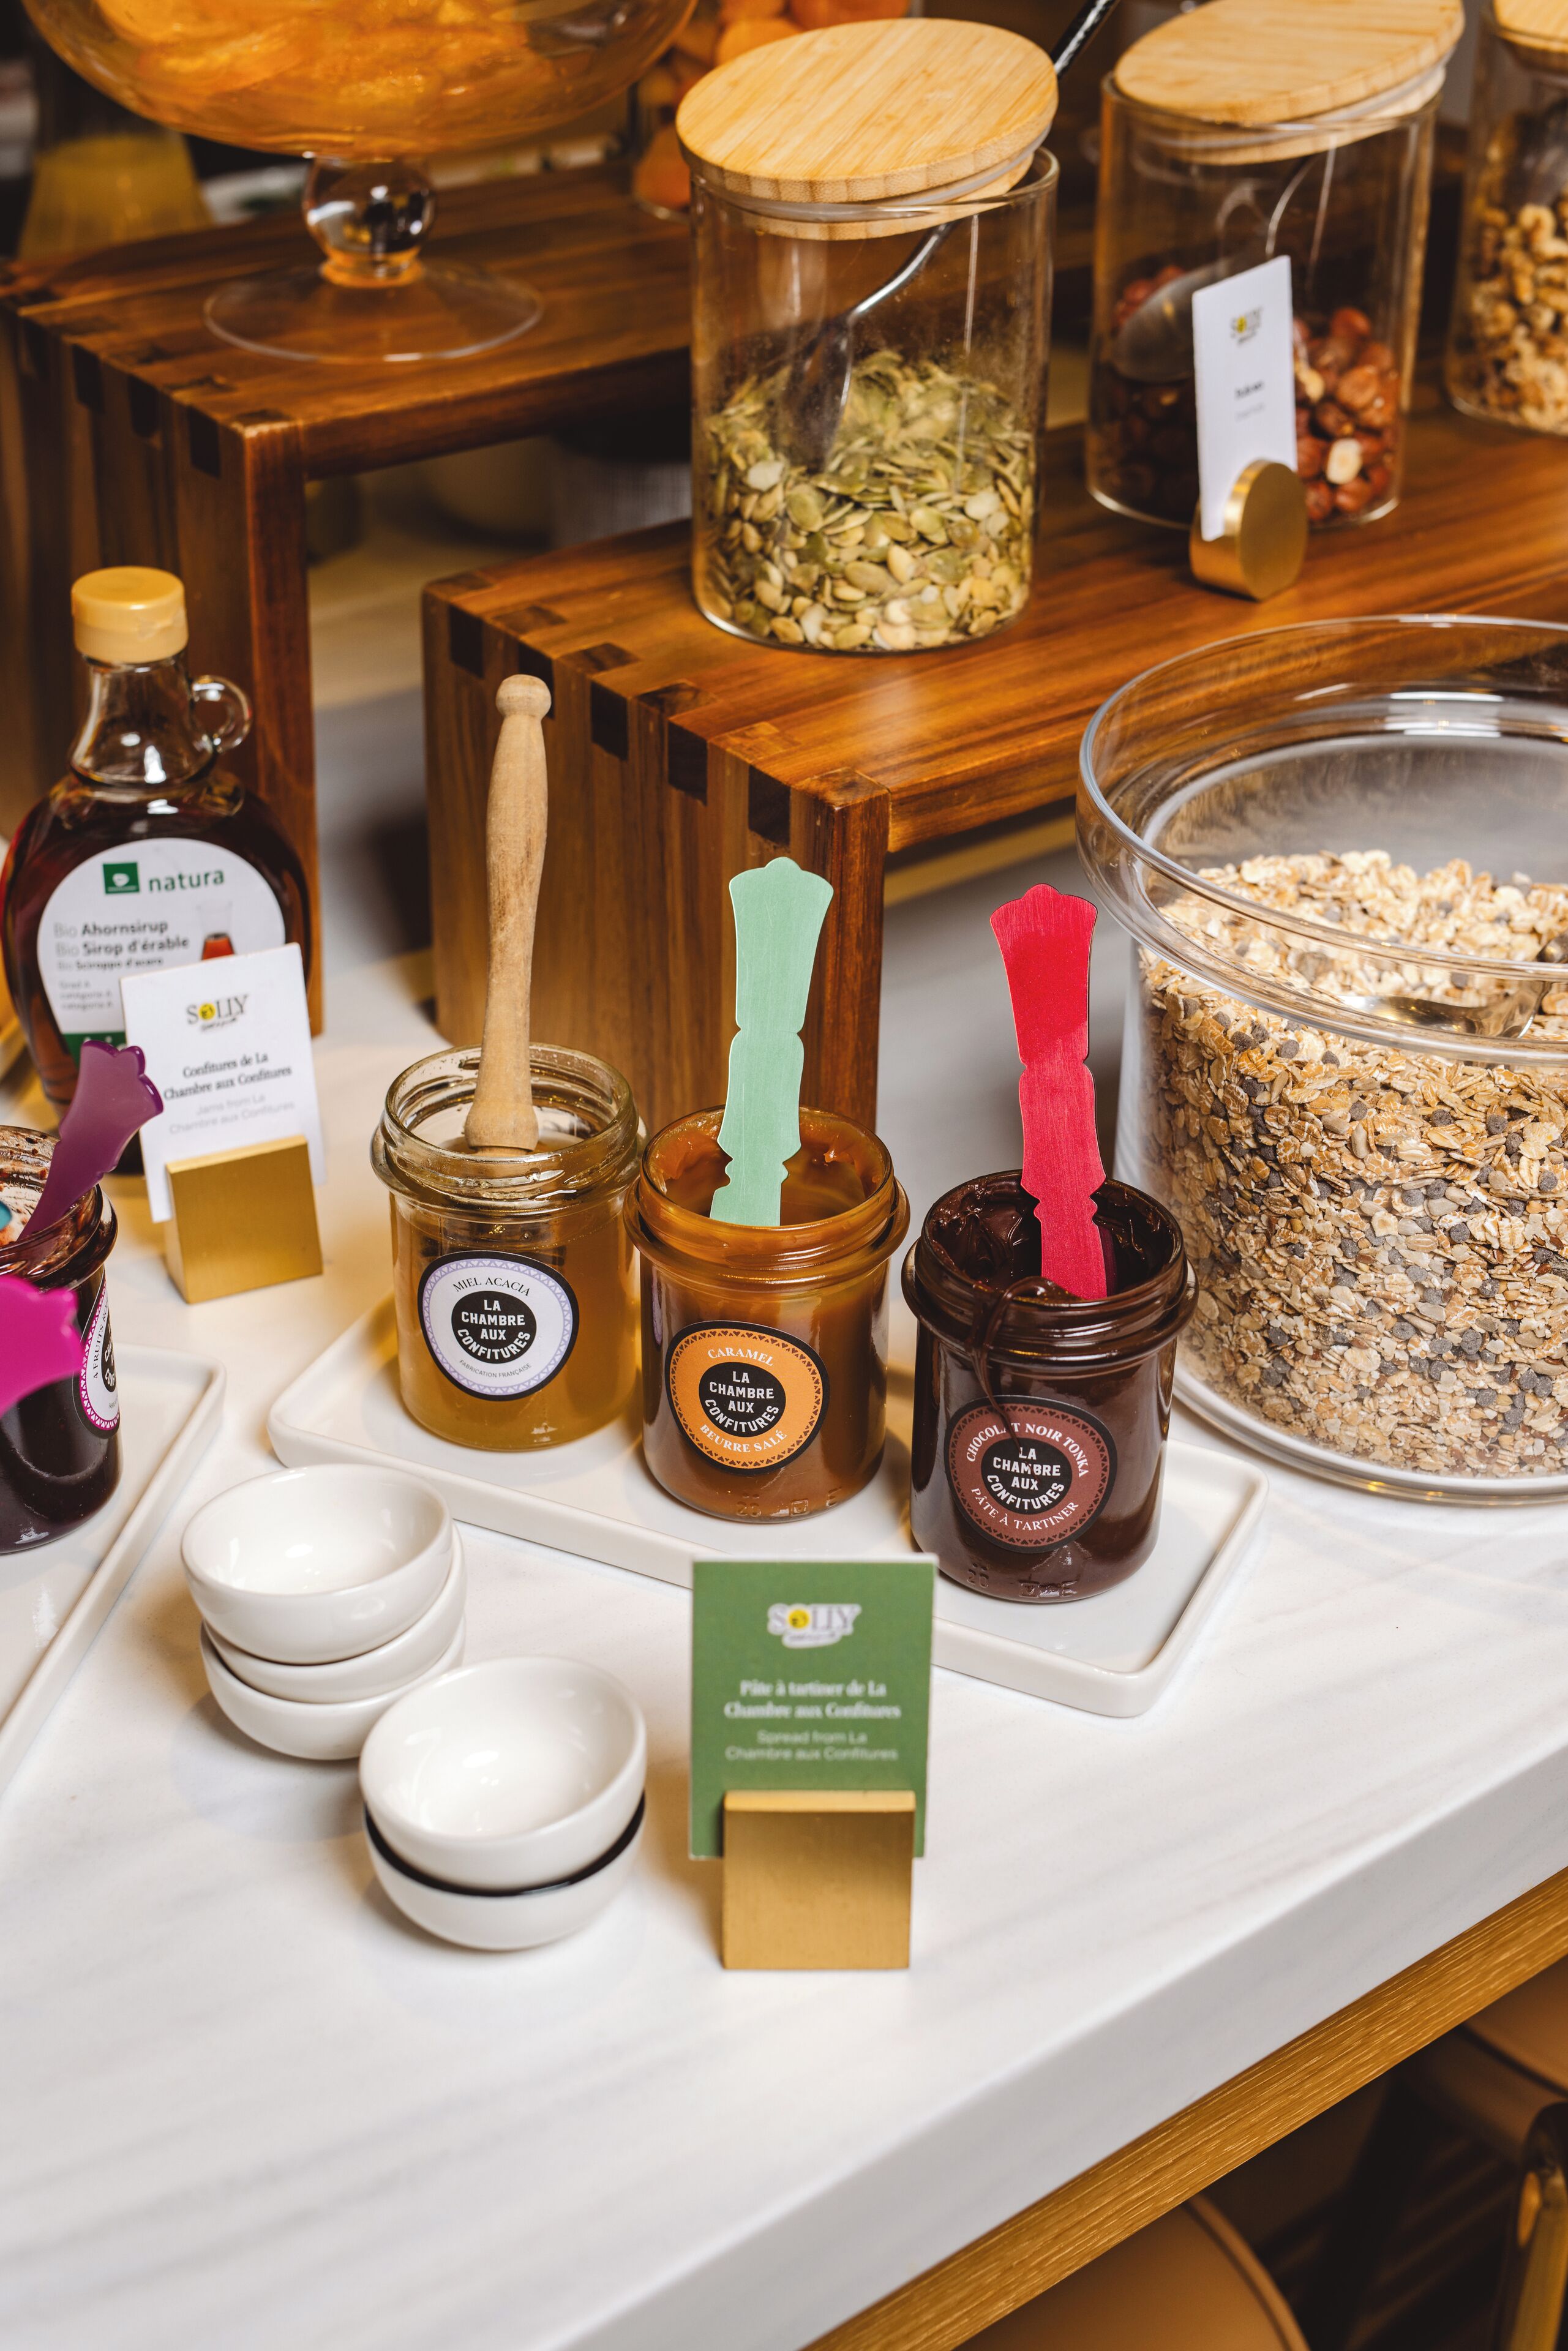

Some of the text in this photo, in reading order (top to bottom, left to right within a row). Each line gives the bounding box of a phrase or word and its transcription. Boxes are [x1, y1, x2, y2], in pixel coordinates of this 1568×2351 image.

[149, 870, 224, 891] natura
[82, 920, 168, 936] Ahornsirup
[83, 940, 122, 956] Sirop
[186, 993, 250, 1026] SOLLY
[183, 1052, 268, 1079] Confitures de La
[163, 1067, 292, 1101] Chambre aux Confitures
[169, 1117, 219, 1134] Chambre
[241, 1100, 295, 1119] Confitures
[452, 1277, 530, 1297] MIEL ACACIA
[483, 1299, 501, 1311] LA
[461, 1311, 525, 1326] CHAMBRE
[457, 1329, 531, 1360] CONFITURES
[480, 1329, 506, 1340] AUX
[92, 1324, 103, 1370] FRUITS
[707, 1347, 773, 1367] CARAMEL
[459, 1359, 532, 1378] FABRICATION FRANÇAISE
[732, 1371, 750, 1384] LA
[710, 1381, 775, 1399] CHAMBRE
[705, 1399, 779, 1433] CONFITURES
[728, 1400, 754, 1413] AUX
[700, 1424, 787, 1453] BEURRE SALÉ
[966, 1422, 1089, 1477] CHOCOLT NOIR TONKA
[1018, 1447, 1037, 1460] LA
[993, 1457, 1061, 1476] CHAMBRE
[987, 1474, 1065, 1510] CONFITURES
[1011, 1477, 1039, 1490] AUX
[971, 1488, 1079, 1531] PÂTE À TARTINER
